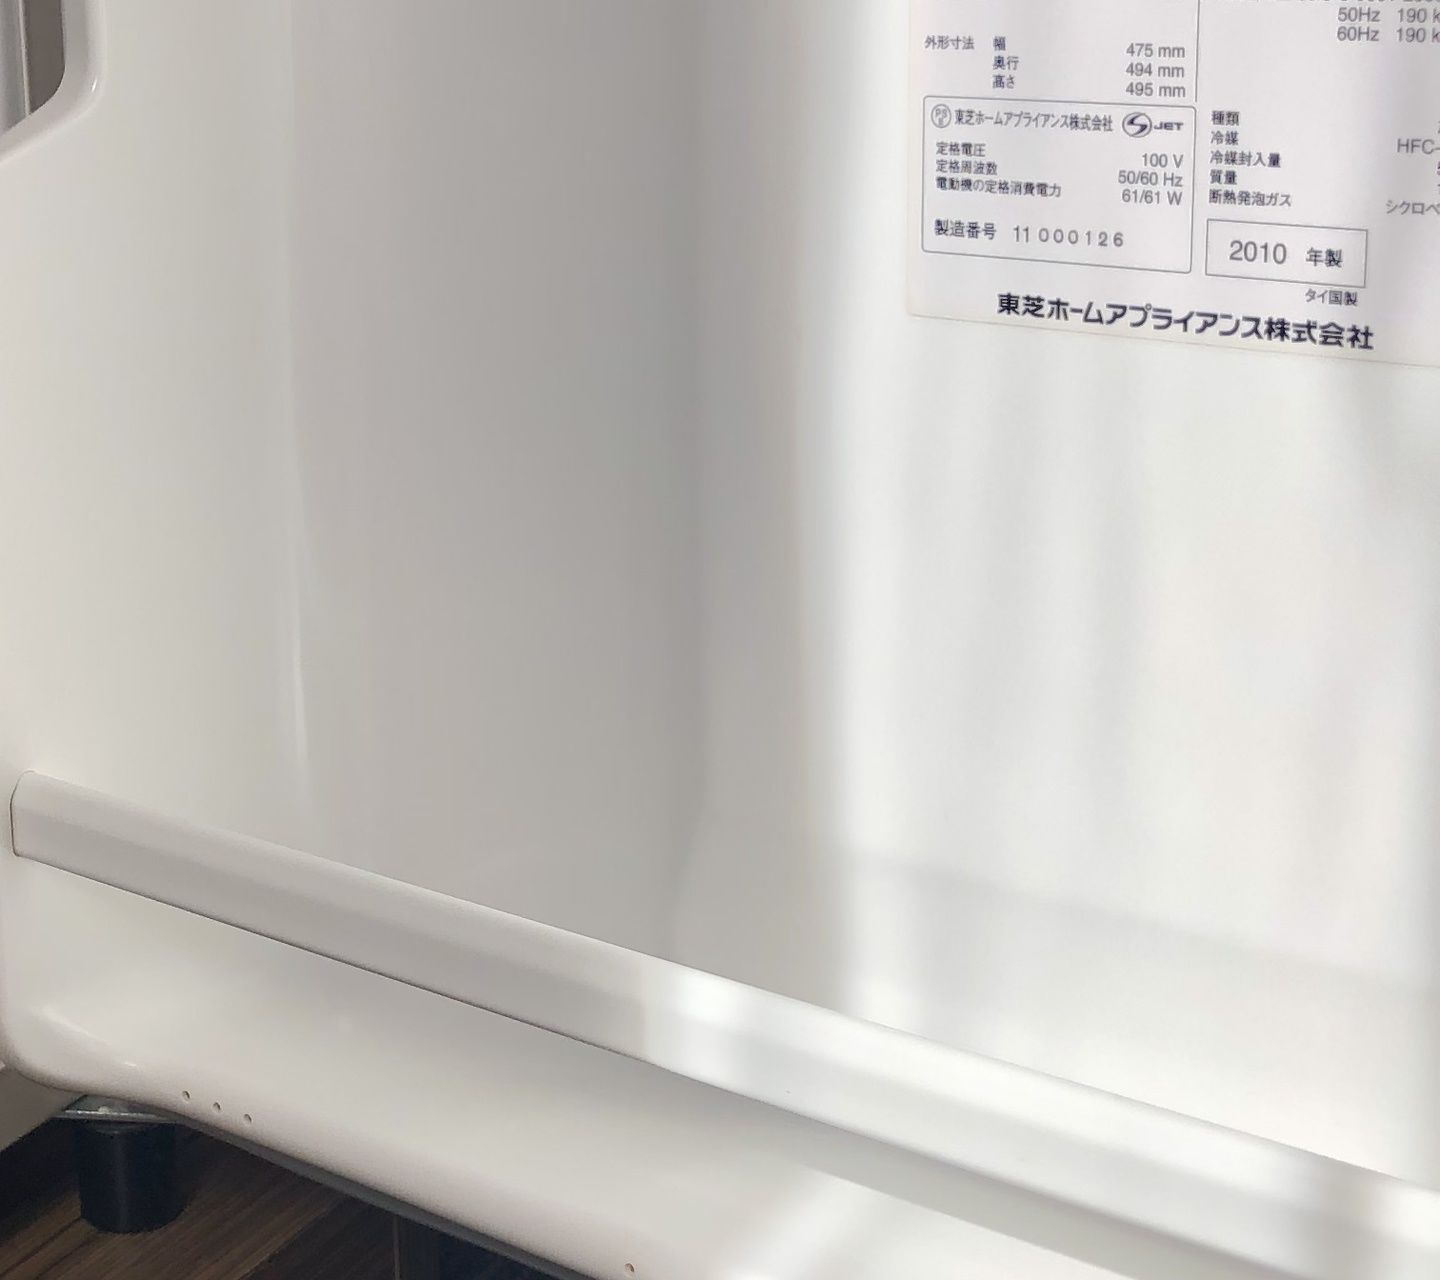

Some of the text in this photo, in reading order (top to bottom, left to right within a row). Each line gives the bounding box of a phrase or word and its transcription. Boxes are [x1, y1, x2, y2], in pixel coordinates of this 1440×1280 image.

[1338, 7, 1381, 22] 50Hz
[1397, 8, 1427, 23] 190
[1337, 26, 1380, 42] 60Hz
[1396, 27, 1426, 43] 190
[925, 35, 1185, 58] 外形寸法 幅 475 mm
[993, 56, 1185, 78] 奥行 494 mm
[992, 74, 1186, 98] 高さ 495 mm
[954, 108, 1113, 132] 東芝ホームアプライアンス株式会社
[1212, 110, 1240, 126] 種類
[1210, 131, 1239, 145] 冷媒
[936, 142, 1184, 169] 定格電圧 100 V
[1210, 150, 1281, 168] 冷媒封入量
[936, 159, 1183, 187] 定格周波数 50/60 Hz
[1210, 169, 1237, 185] 質量
[936, 176, 1182, 206] 電動機の定格消費電力 61/61 W
[1208, 189, 1292, 207] 断熱発泡ガス
[934, 219, 997, 240] 製造番号
[1229, 240, 1343, 268] 2010 年製
[1304, 288, 1359, 307] タイ国製
[998, 292, 1375, 351] 東芝ホームアプライアンス株式会社
